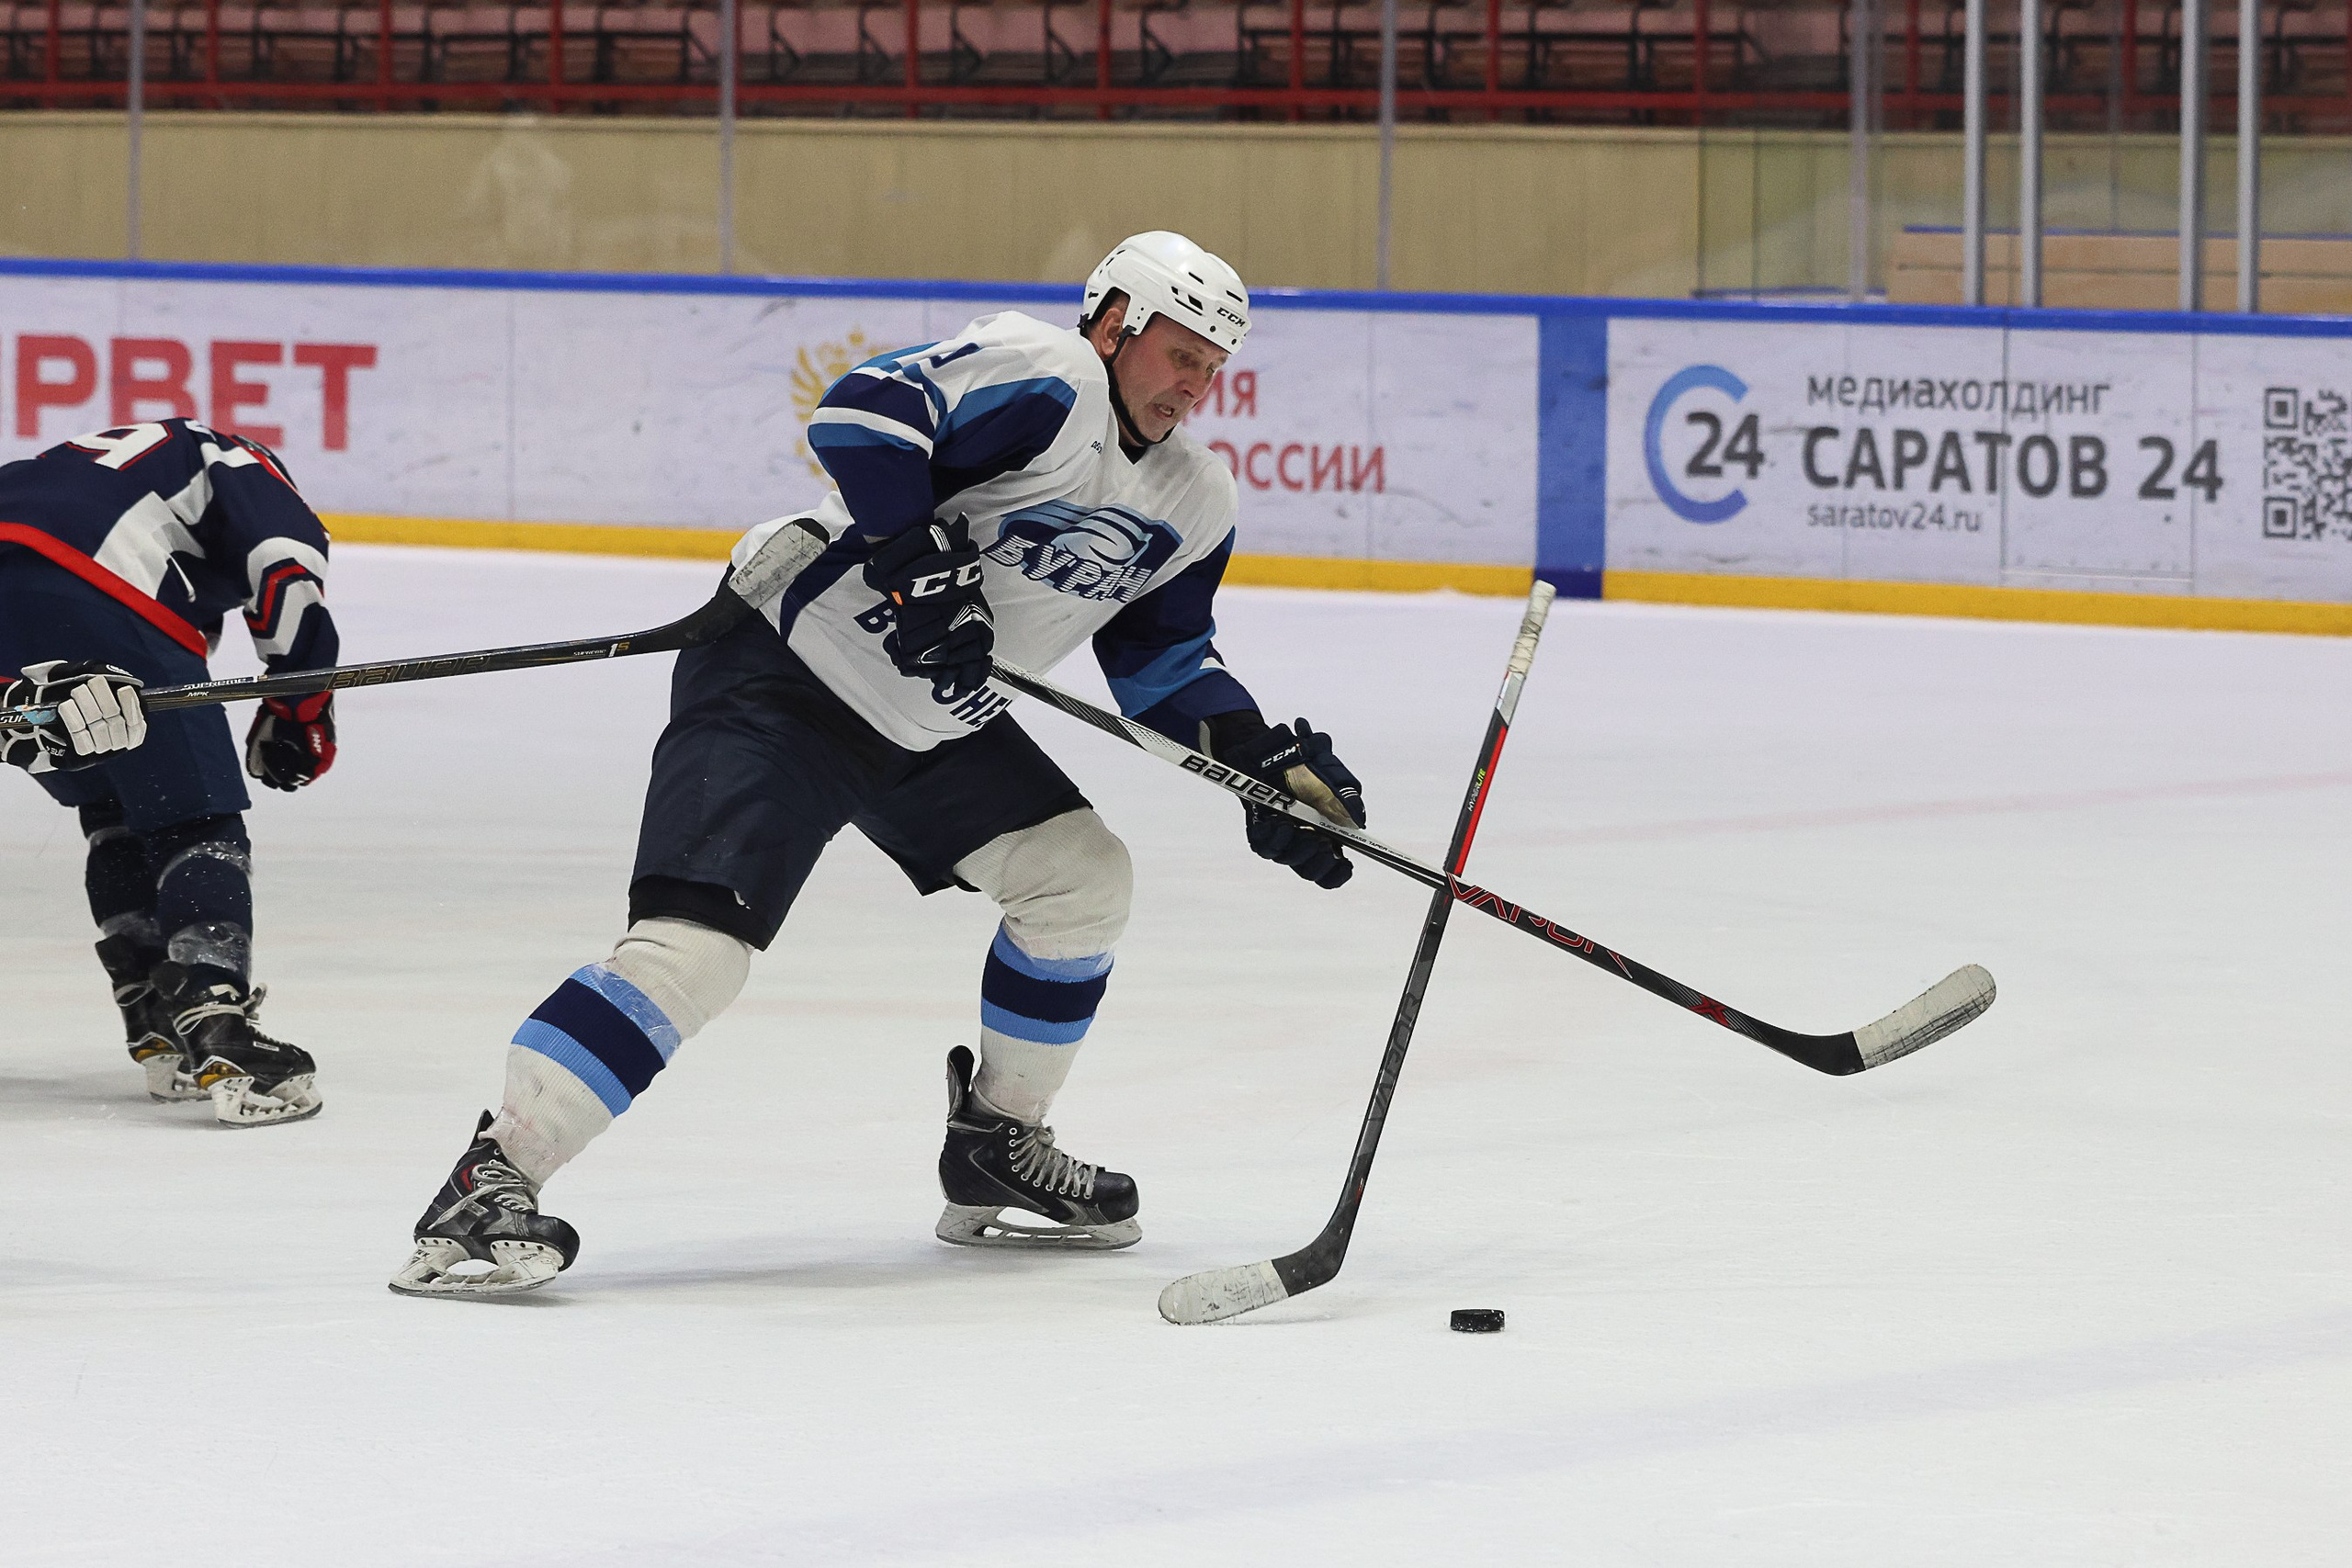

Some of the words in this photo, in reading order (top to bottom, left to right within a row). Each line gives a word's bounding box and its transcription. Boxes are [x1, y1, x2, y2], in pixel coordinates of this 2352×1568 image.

[1216, 306, 1246, 328] CCM
[0, 333, 378, 453] РВЕТ
[1182, 369, 1256, 426] ИЯ
[1807, 375, 2110, 421] медиахолдинг
[1685, 411, 1766, 480] 24
[1802, 425, 2109, 500] САРАТОВ
[2137, 435, 2224, 503] 24
[1806, 502, 1982, 533] saratov24.ru
[979, 533, 1154, 604] БУРАН
[1179, 753, 1297, 812] BAUER
[1261, 745, 1296, 769] CCM
[1466, 768, 1487, 812] HYPERLITE
